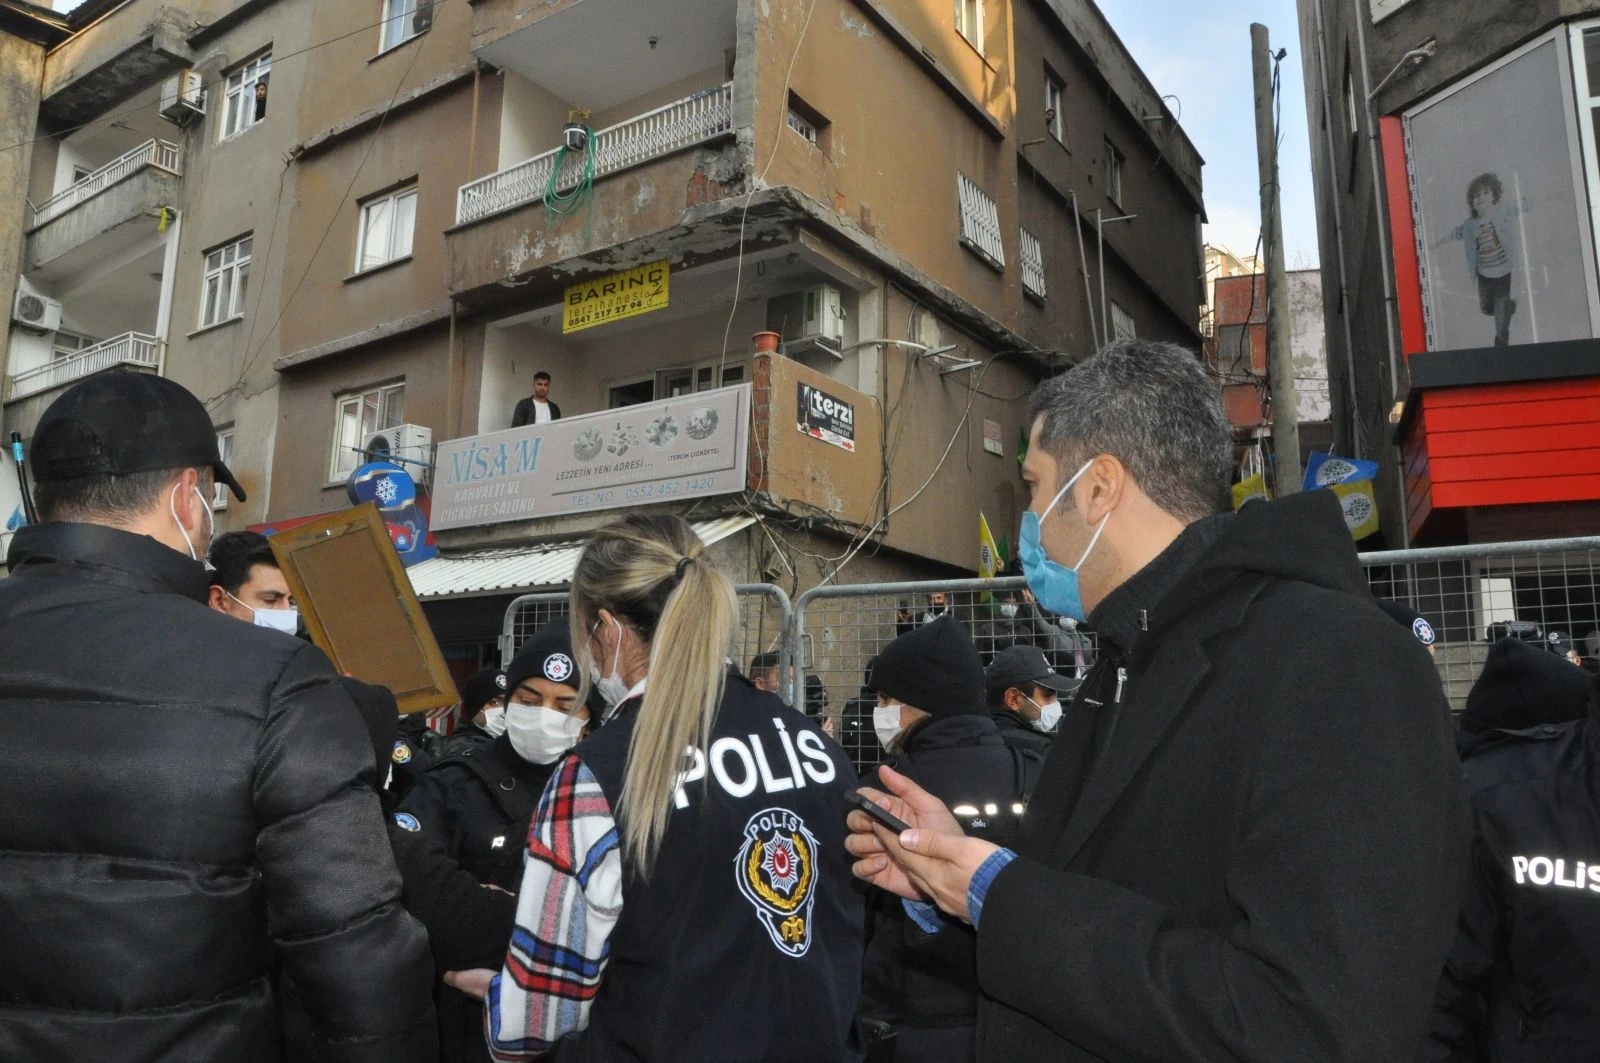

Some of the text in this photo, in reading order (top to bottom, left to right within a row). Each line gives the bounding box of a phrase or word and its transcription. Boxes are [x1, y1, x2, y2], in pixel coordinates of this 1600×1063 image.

[569, 269, 663, 306] BARINÇ
[568, 300, 642, 327] 0541 217 27 94
[569, 288, 643, 318] terzihanesi
[813, 391, 853, 425] terzi
[555, 466, 592, 481] LEZZETİN
[594, 461, 612, 475] YENİ
[454, 480, 521, 503] KAHVALTI VE
[571, 493, 591, 507] TEL
[625, 486, 653, 500] 0552
[657, 482, 681, 496] 452
[685, 476, 715, 491] 1420
[492, 497, 536, 517] SALONU
[671, 717, 836, 809] POLİS
[749, 812, 798, 840] POLİS
